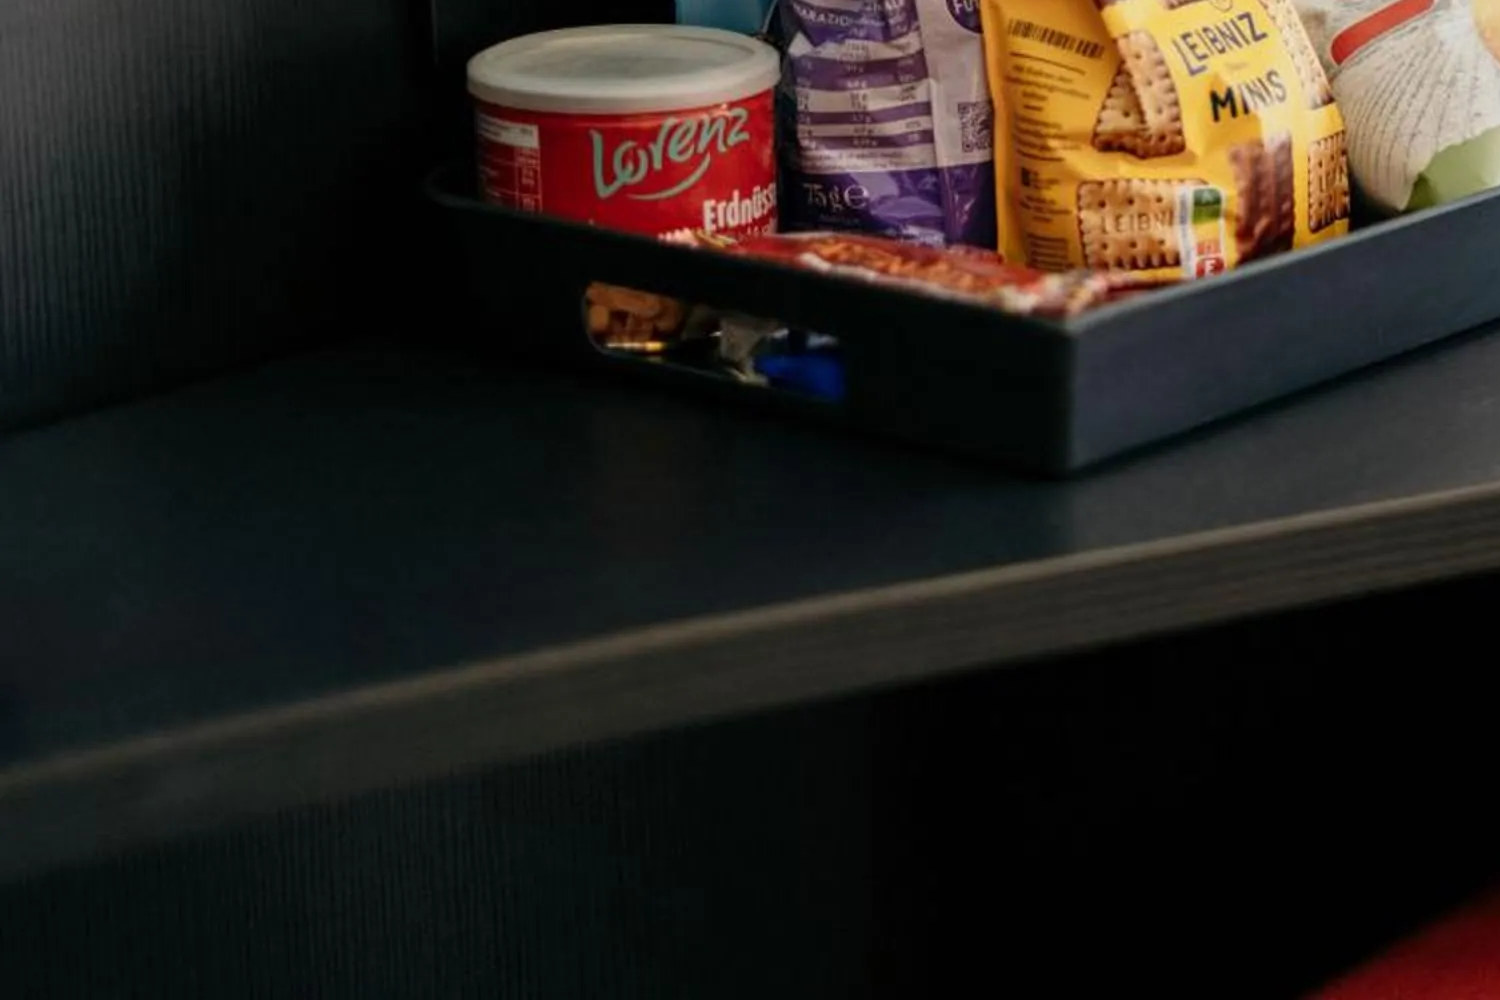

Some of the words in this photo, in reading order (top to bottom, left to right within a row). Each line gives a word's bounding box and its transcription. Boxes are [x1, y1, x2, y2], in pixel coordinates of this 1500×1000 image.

[1172, 12, 1268, 77] LEIBNIZ
[1209, 69, 1288, 123] MINIS
[590, 107, 750, 200] Lorenz
